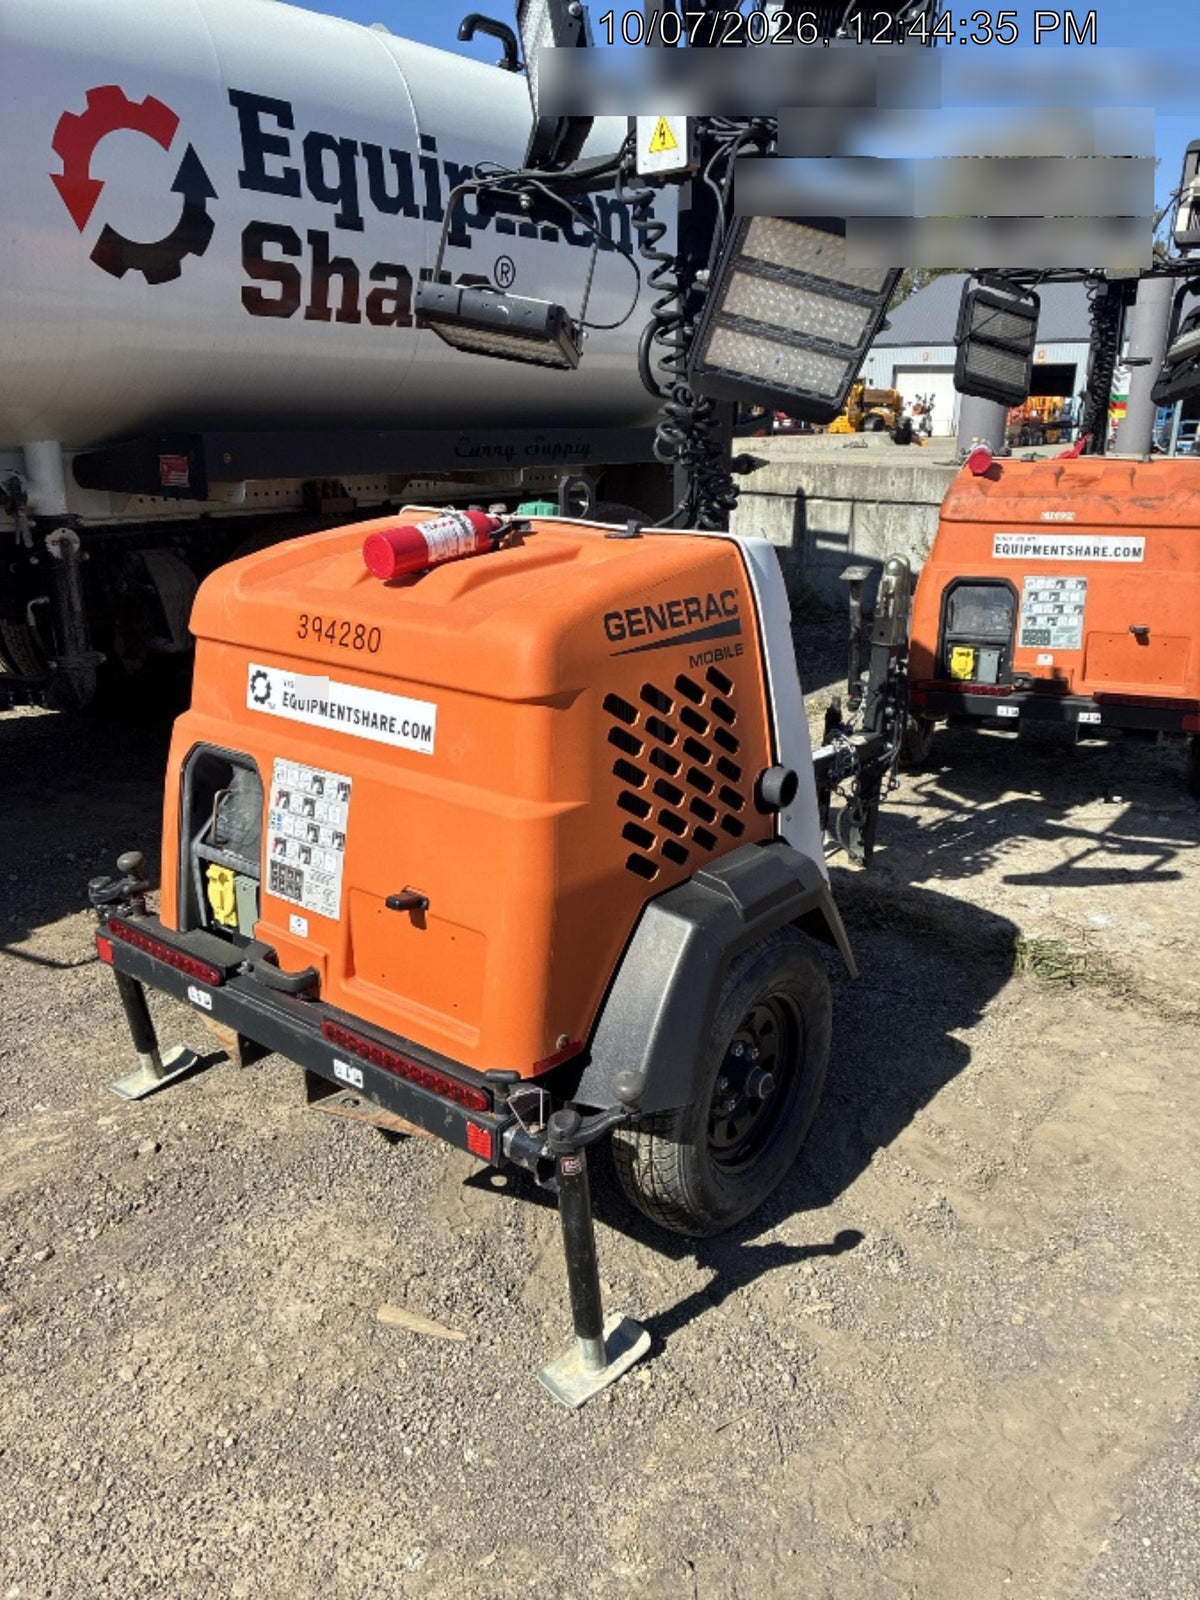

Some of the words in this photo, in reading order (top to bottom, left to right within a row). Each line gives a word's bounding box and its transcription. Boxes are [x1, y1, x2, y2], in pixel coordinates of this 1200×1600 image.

[227, 88, 657, 255] Equipent
[995, 543, 1142, 558] EQUIPMENTSHARE.COM
[297, 614, 382, 654] 394280
[604, 589, 739, 642] GENERAC
[689, 643, 745, 669] MOBILE
[281, 690, 433, 743] EQUIPMENTSHARE.COM
